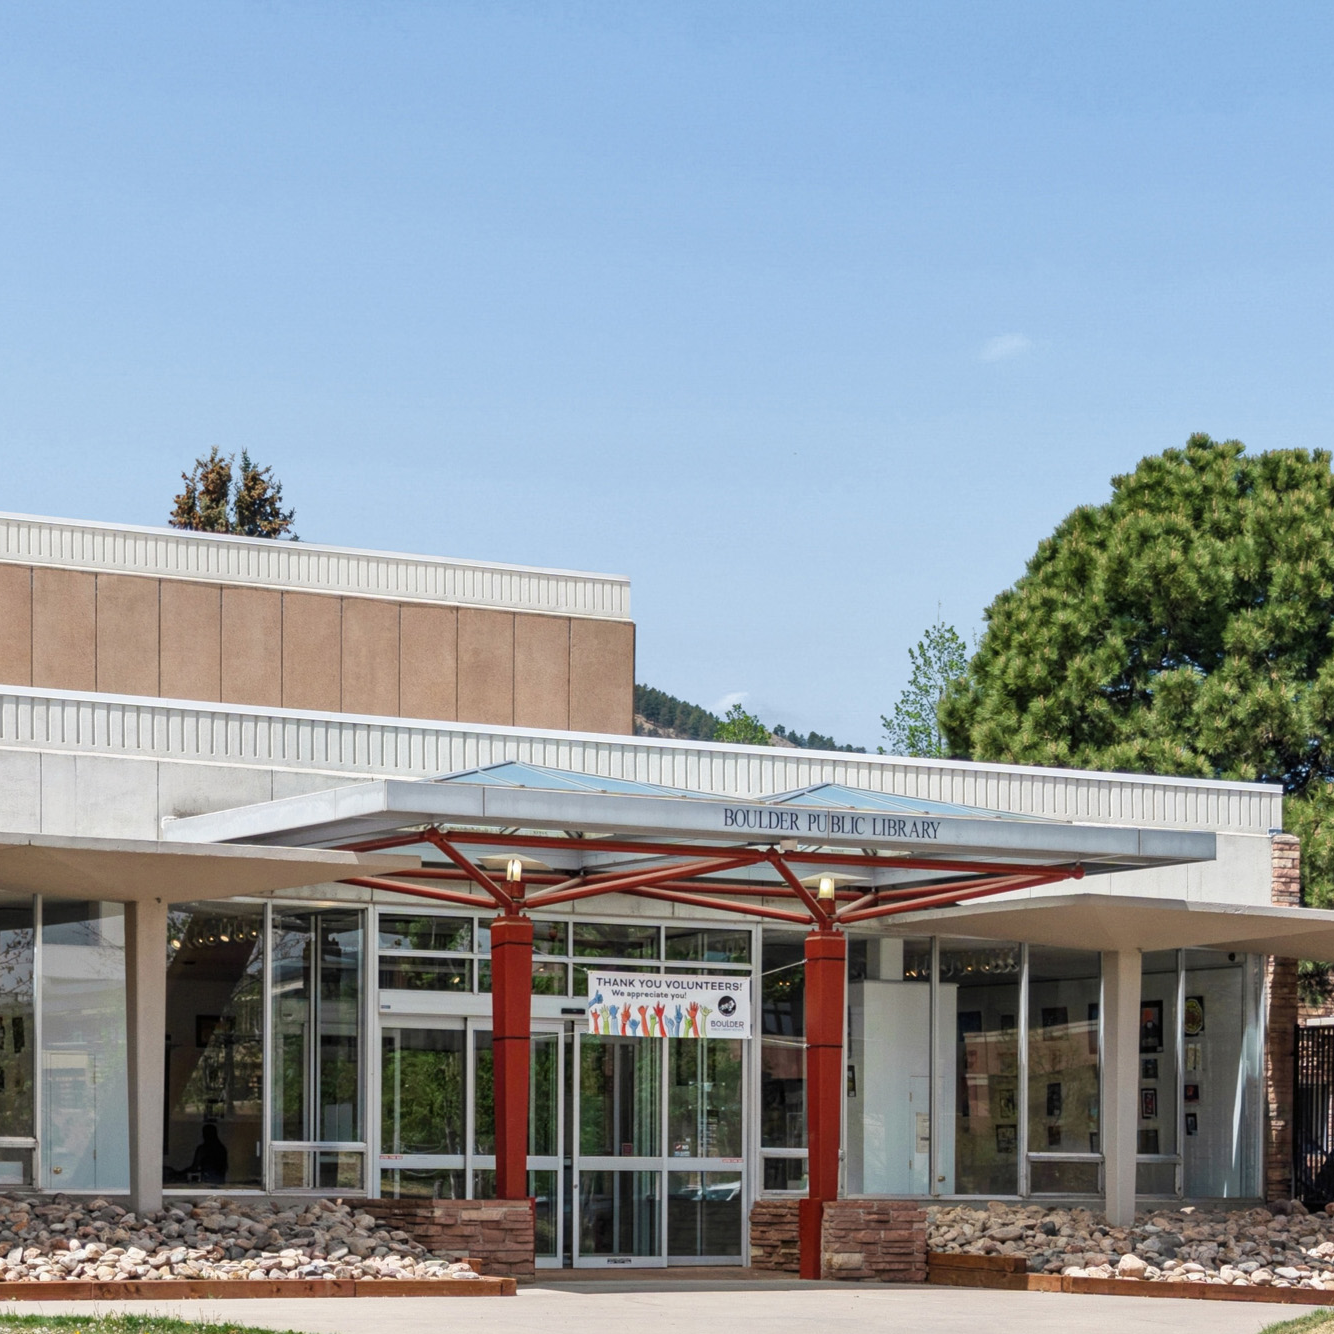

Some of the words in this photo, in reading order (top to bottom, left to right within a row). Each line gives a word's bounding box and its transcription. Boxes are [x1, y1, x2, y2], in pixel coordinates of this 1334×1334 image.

[724, 808, 800, 831] BOULDER
[807, 813, 866, 835] PUBLIC
[872, 817, 942, 839] LIBRARY
[596, 977, 635, 988] THANK
[640, 979, 662, 989] YOU
[665, 980, 743, 991] VOLUNTEERS!
[611, 989, 625, 997] We
[626, 990, 669, 999] appreciate
[671, 992, 687, 1000] you!
[710, 1020, 745, 1029] BOULDER
